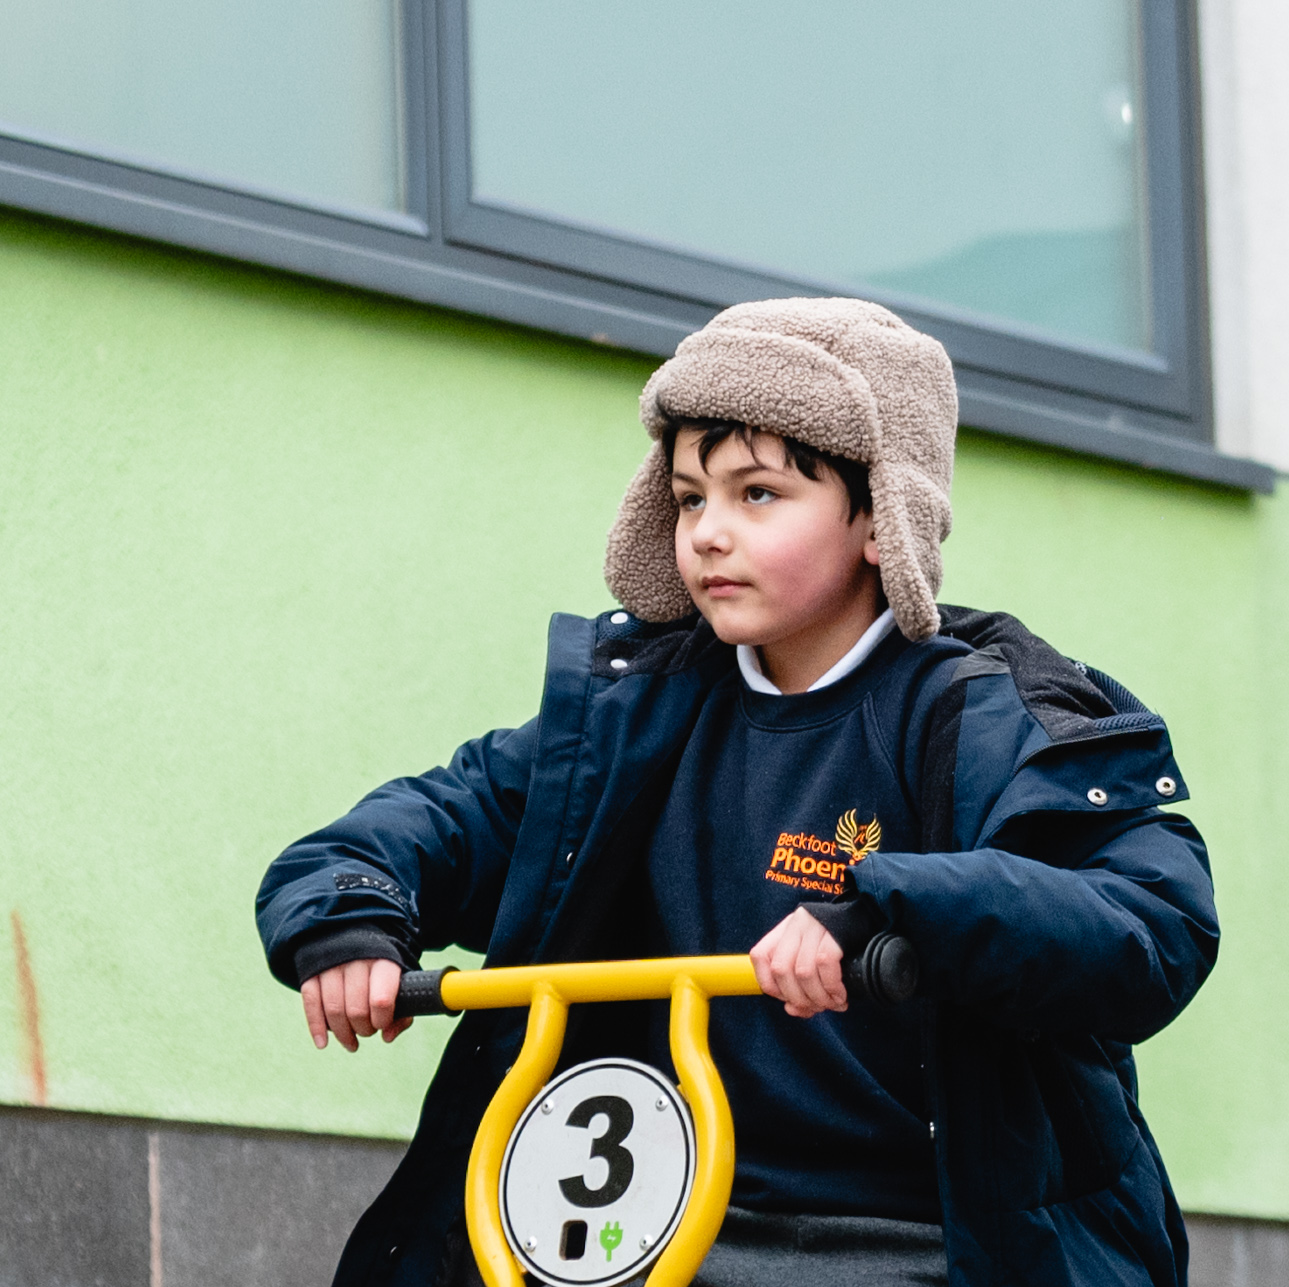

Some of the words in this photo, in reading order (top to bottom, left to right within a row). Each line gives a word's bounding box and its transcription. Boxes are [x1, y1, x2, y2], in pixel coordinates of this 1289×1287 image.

[777, 831, 837, 857] Beckfoot
[765, 869, 800, 888] Primary
[800, 877, 833, 894] Special
[558, 1095, 634, 1209] 3
